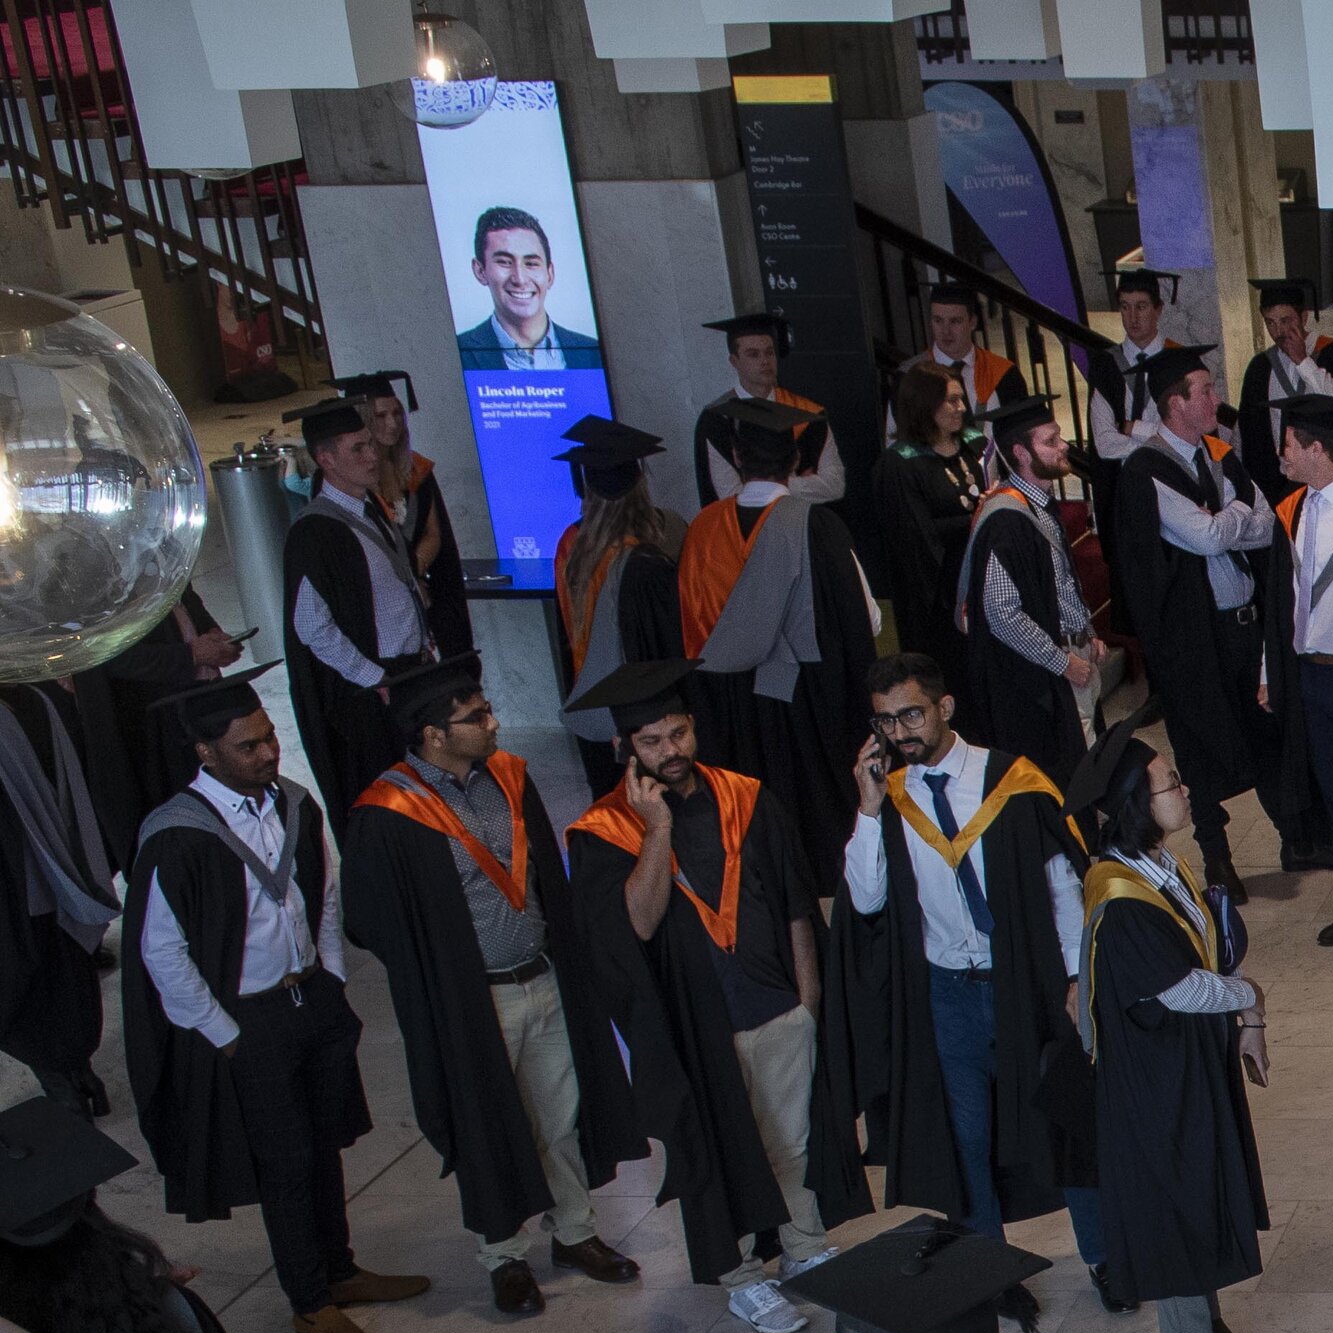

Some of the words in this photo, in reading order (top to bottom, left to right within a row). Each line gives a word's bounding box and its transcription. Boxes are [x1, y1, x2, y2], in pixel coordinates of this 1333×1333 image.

[477, 385, 525, 397] Lincoln
[526, 385, 565, 399] Roper
[521, 402, 567, 411] Agribusiness
[516, 410, 551, 419] Marketing
